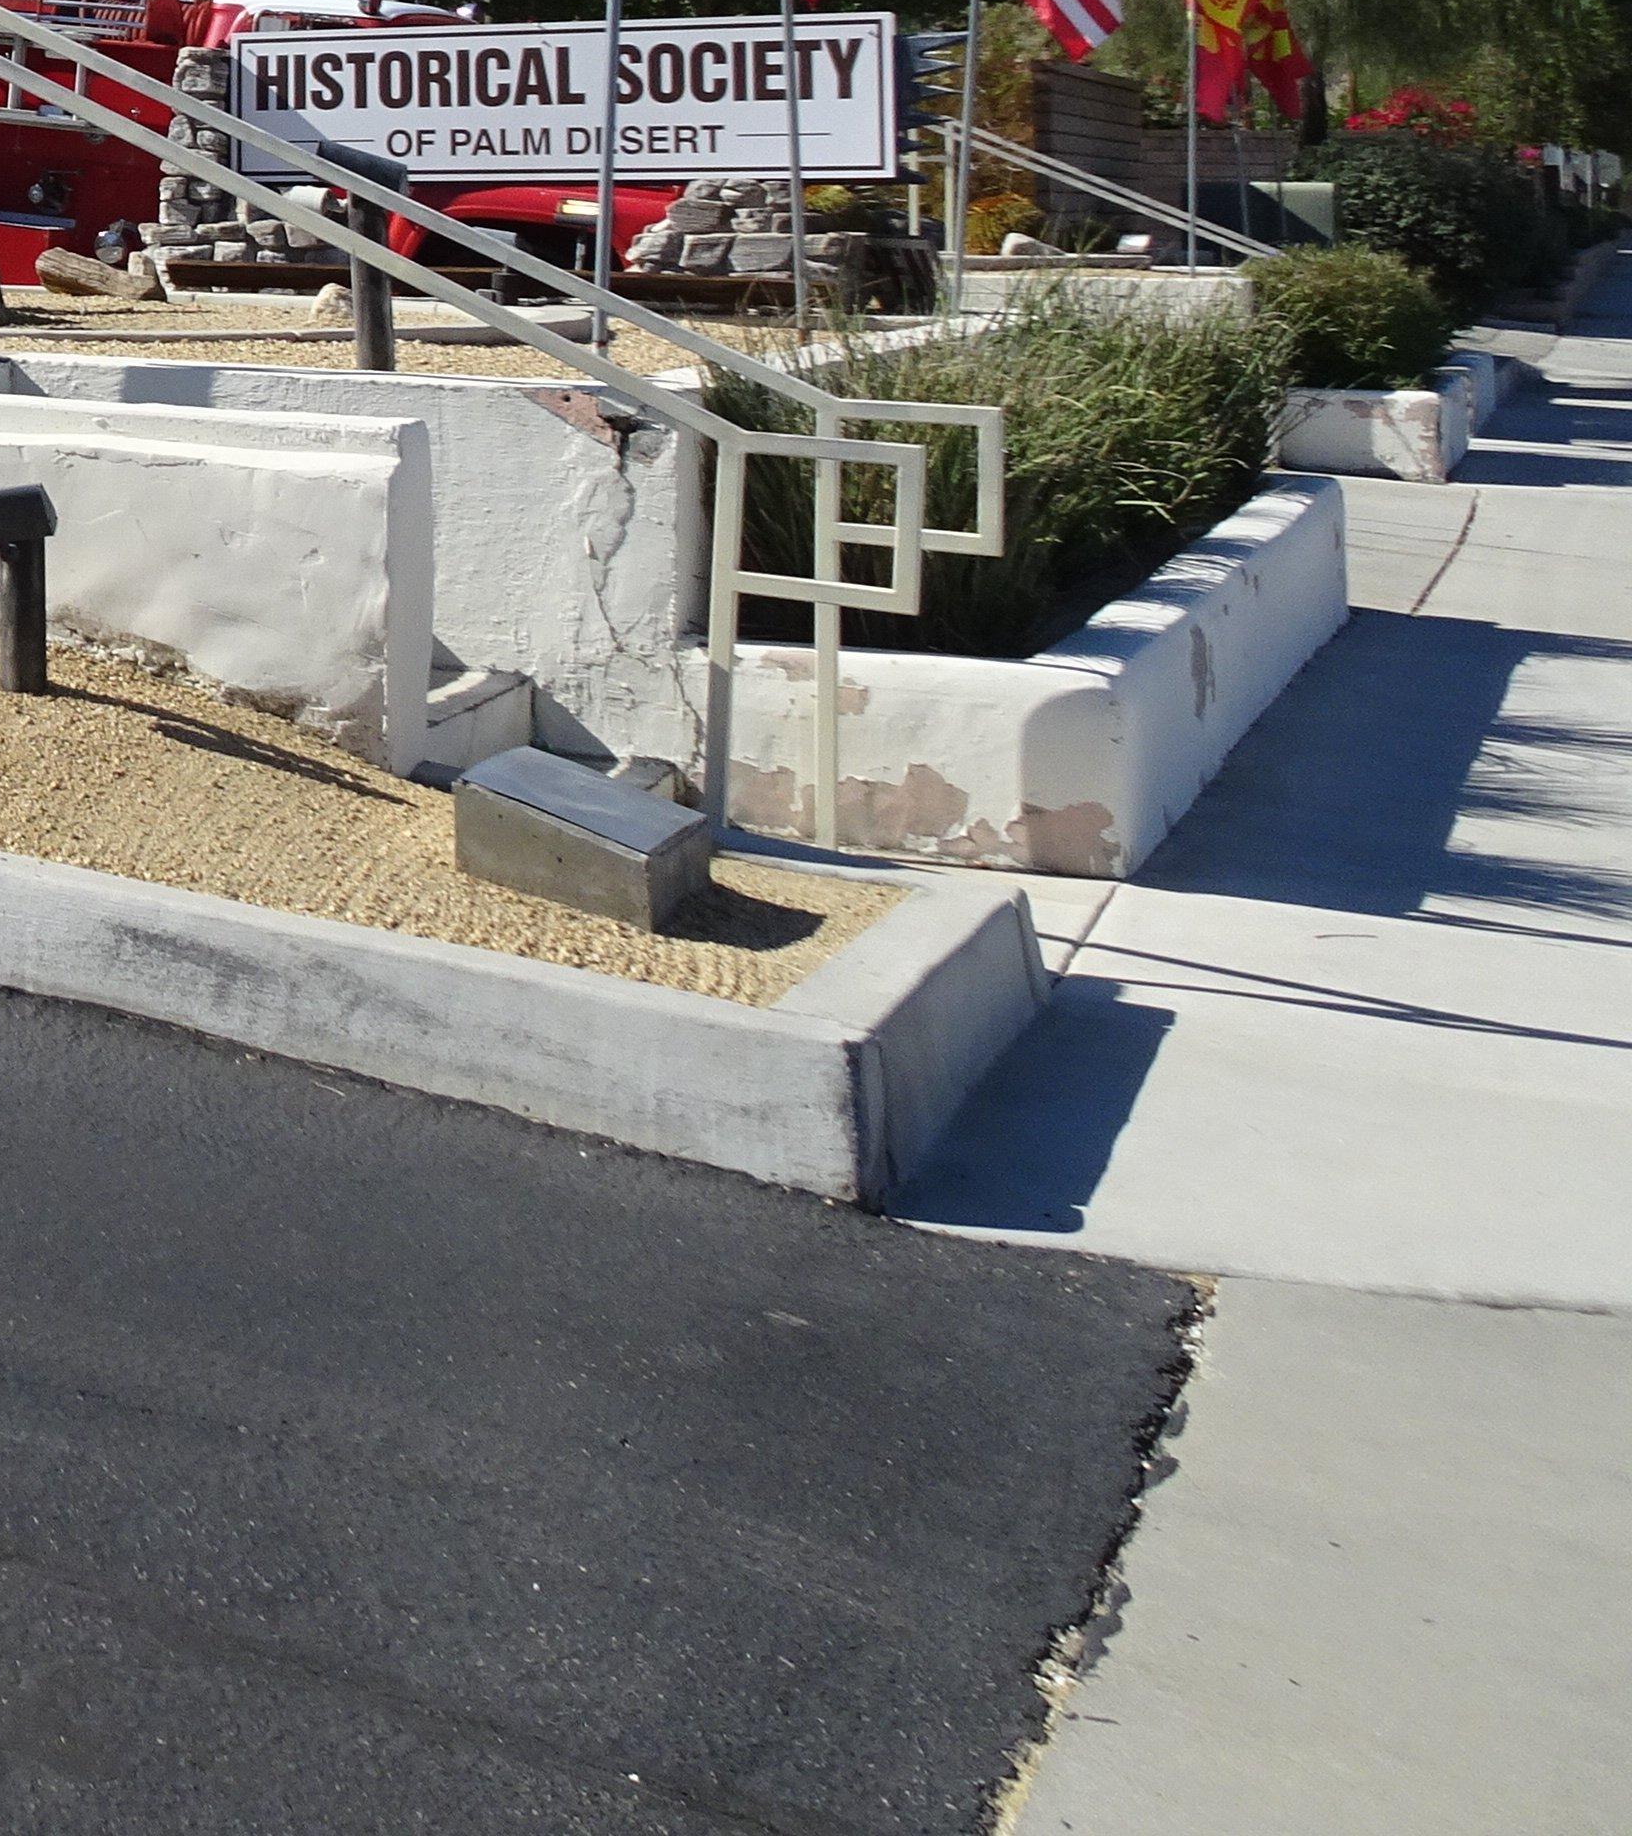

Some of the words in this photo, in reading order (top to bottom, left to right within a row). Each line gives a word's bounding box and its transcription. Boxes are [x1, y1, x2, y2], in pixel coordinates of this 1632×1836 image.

[255, 46, 586, 111] HISTORICAL
[614, 38, 864, 104] SOCIETY
[386, 129, 436, 157] OF
[450, 127, 551, 156] PALM
